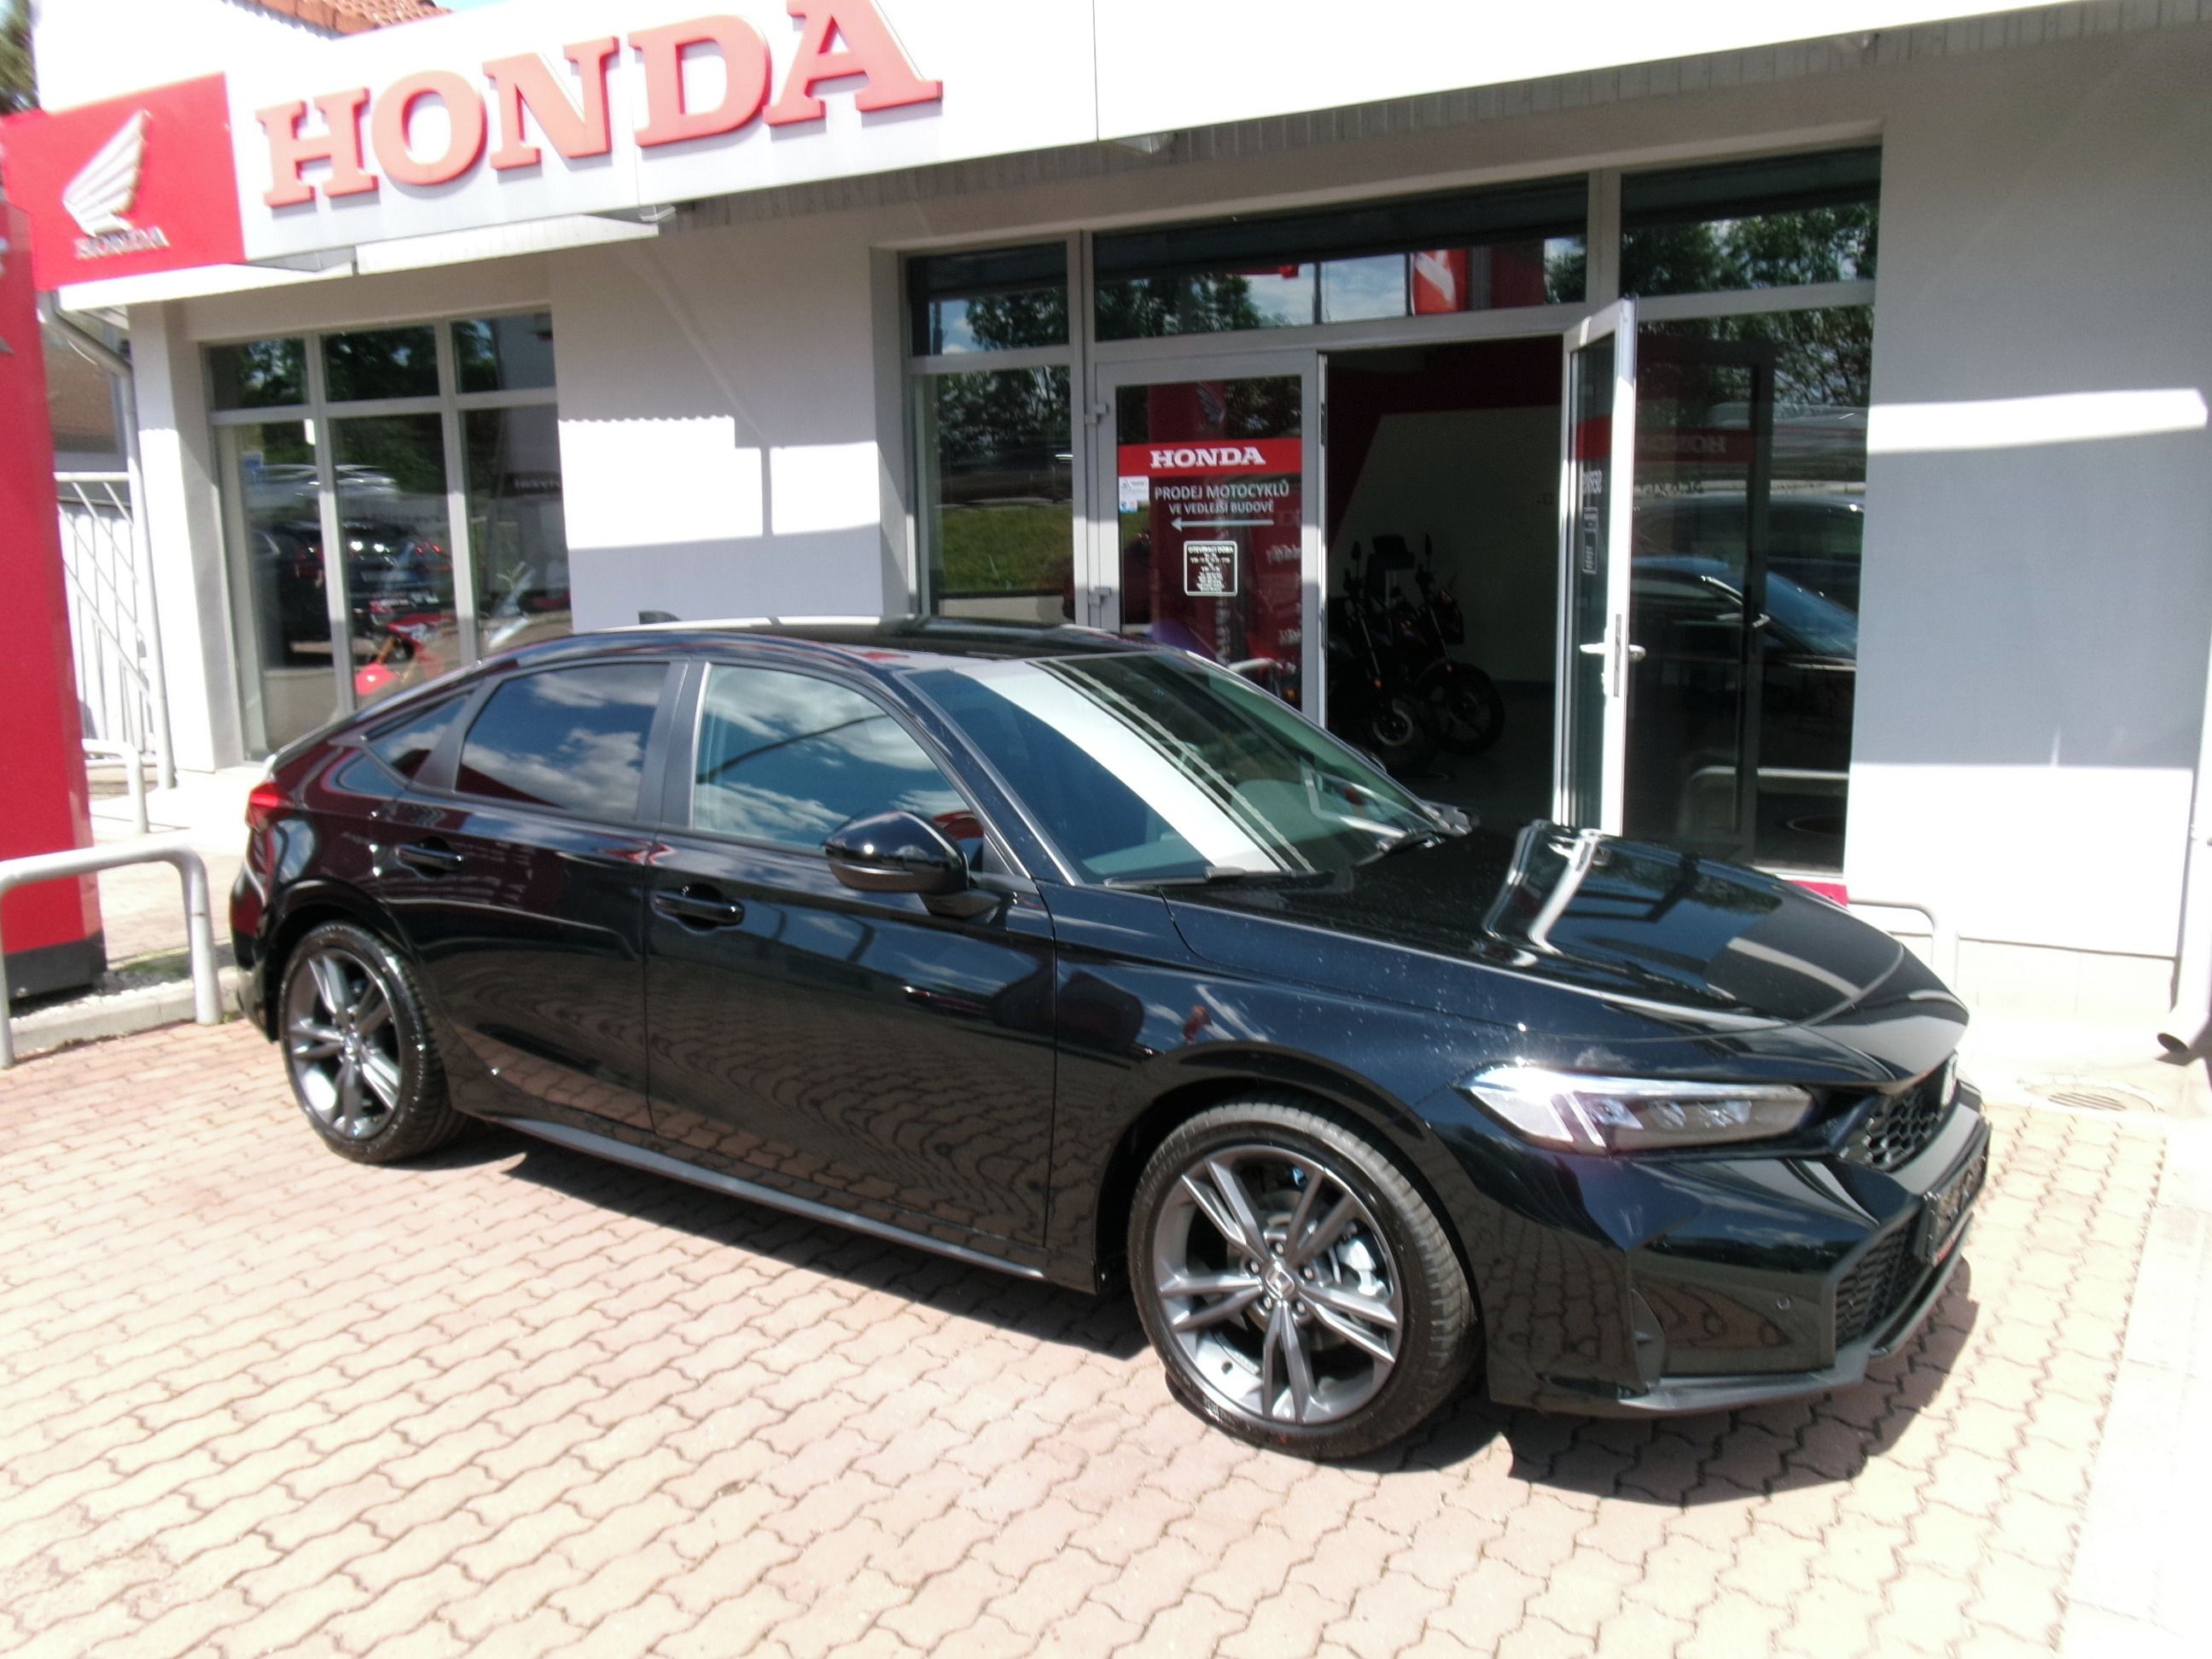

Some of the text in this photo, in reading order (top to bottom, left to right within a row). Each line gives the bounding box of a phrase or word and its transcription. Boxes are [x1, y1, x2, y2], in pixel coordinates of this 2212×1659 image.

[254, 0, 943, 208] HONDA
[1150, 446, 1266, 469] HONDA
[1154, 486, 1202, 501] PRODEJ
[1206, 479, 1289, 499] MOTOCYKLŮ
[1168, 503, 1182, 515] VE
[1231, 499, 1274, 513] BUDOVĚ
